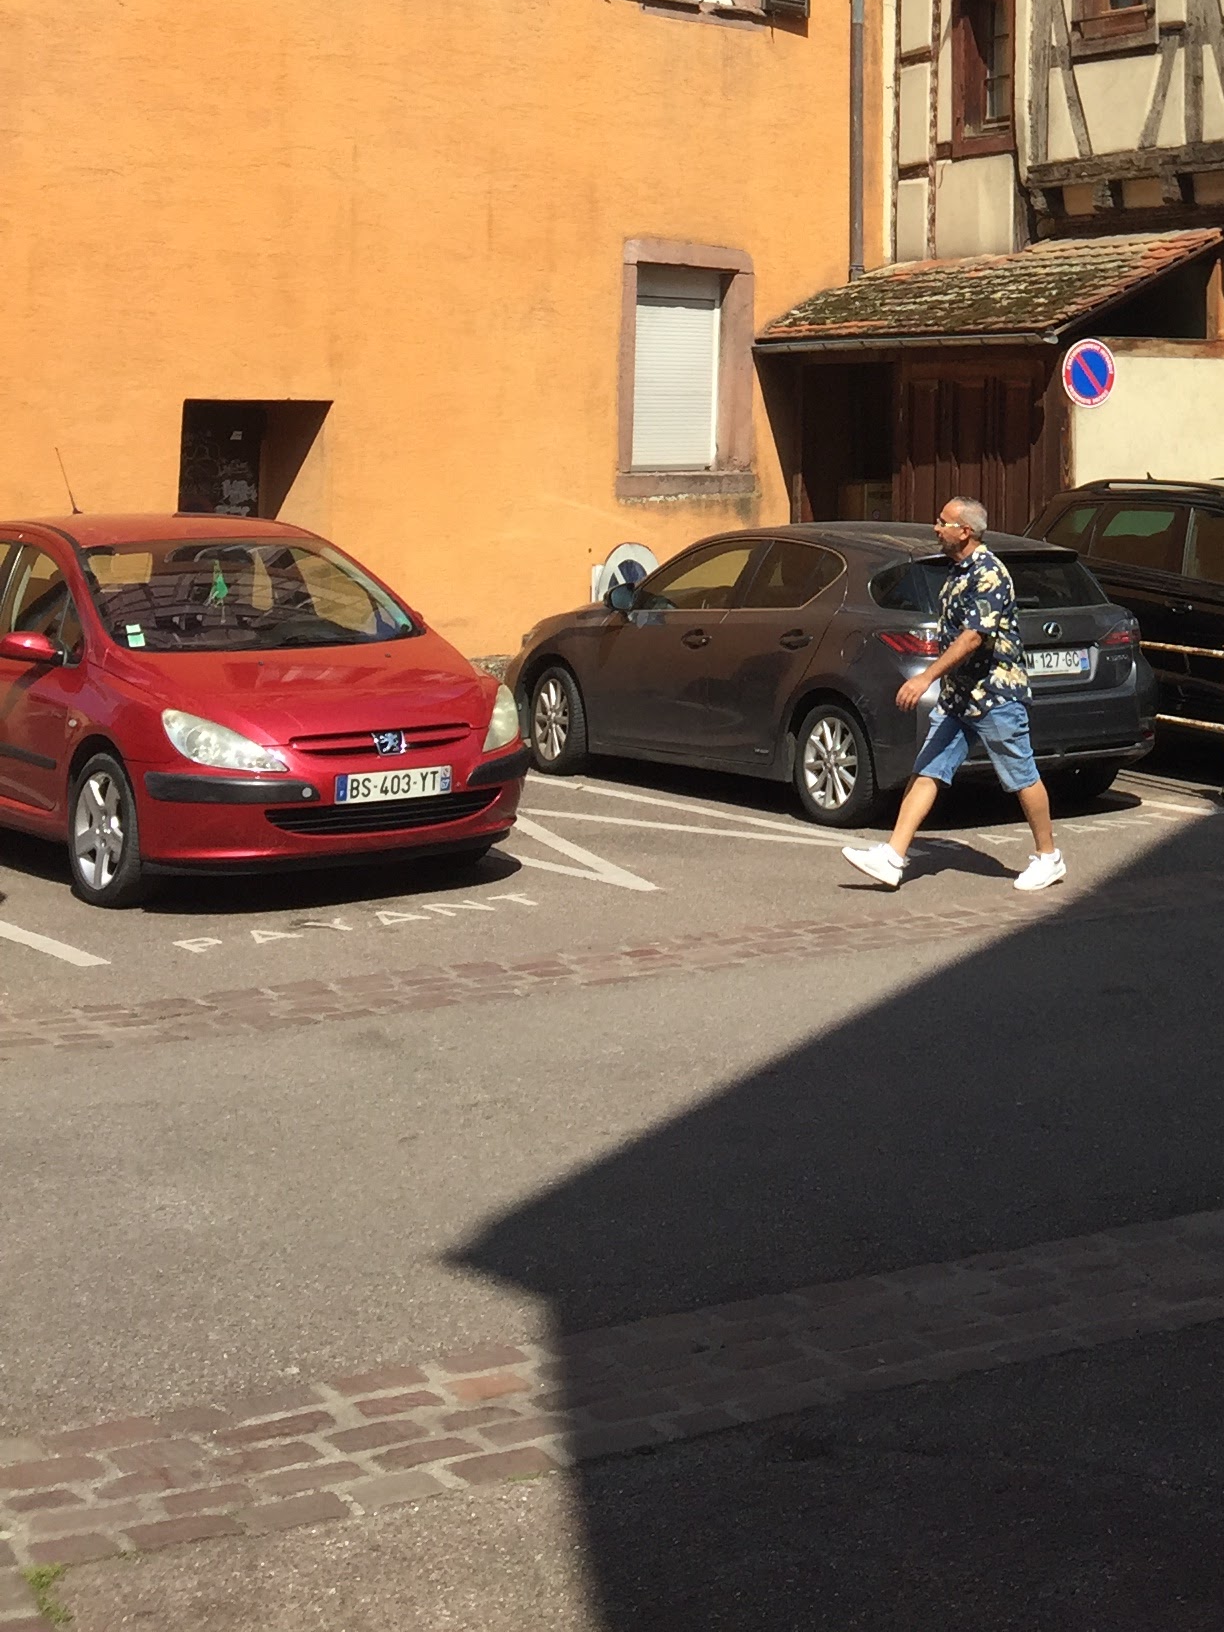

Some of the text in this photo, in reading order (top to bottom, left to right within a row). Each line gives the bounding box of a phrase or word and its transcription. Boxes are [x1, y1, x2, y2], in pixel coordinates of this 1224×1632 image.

[1027, 652, 1080, 669] M-127-GC
[350, 770, 439, 799] BS-403-YT
[172, 893, 538, 953] PAYANT
